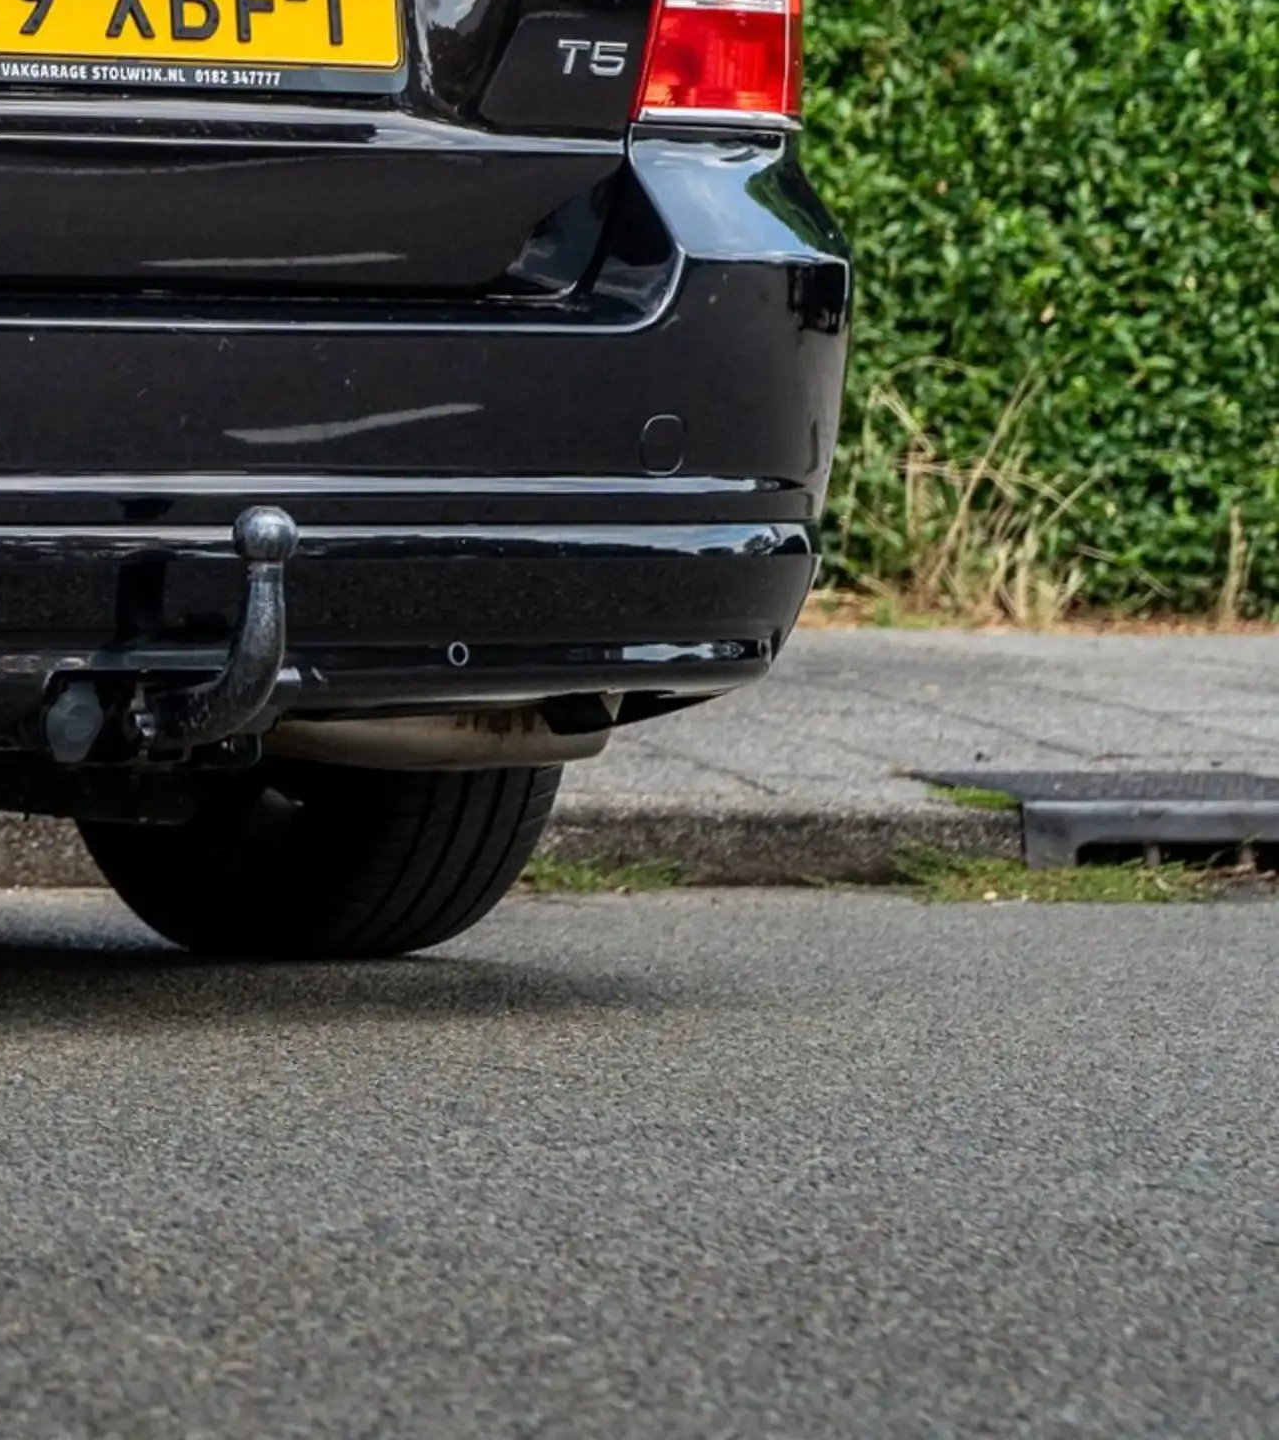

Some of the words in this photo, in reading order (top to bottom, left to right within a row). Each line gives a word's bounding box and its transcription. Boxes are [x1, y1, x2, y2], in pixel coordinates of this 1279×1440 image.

[557, 39, 628, 77] T5
[1, 62, 87, 80] VAKGARAGE
[92, 66, 186, 83] STOLWIJK.NL
[195, 70, 228, 85] 0182
[232, 70, 281, 87] 347777
